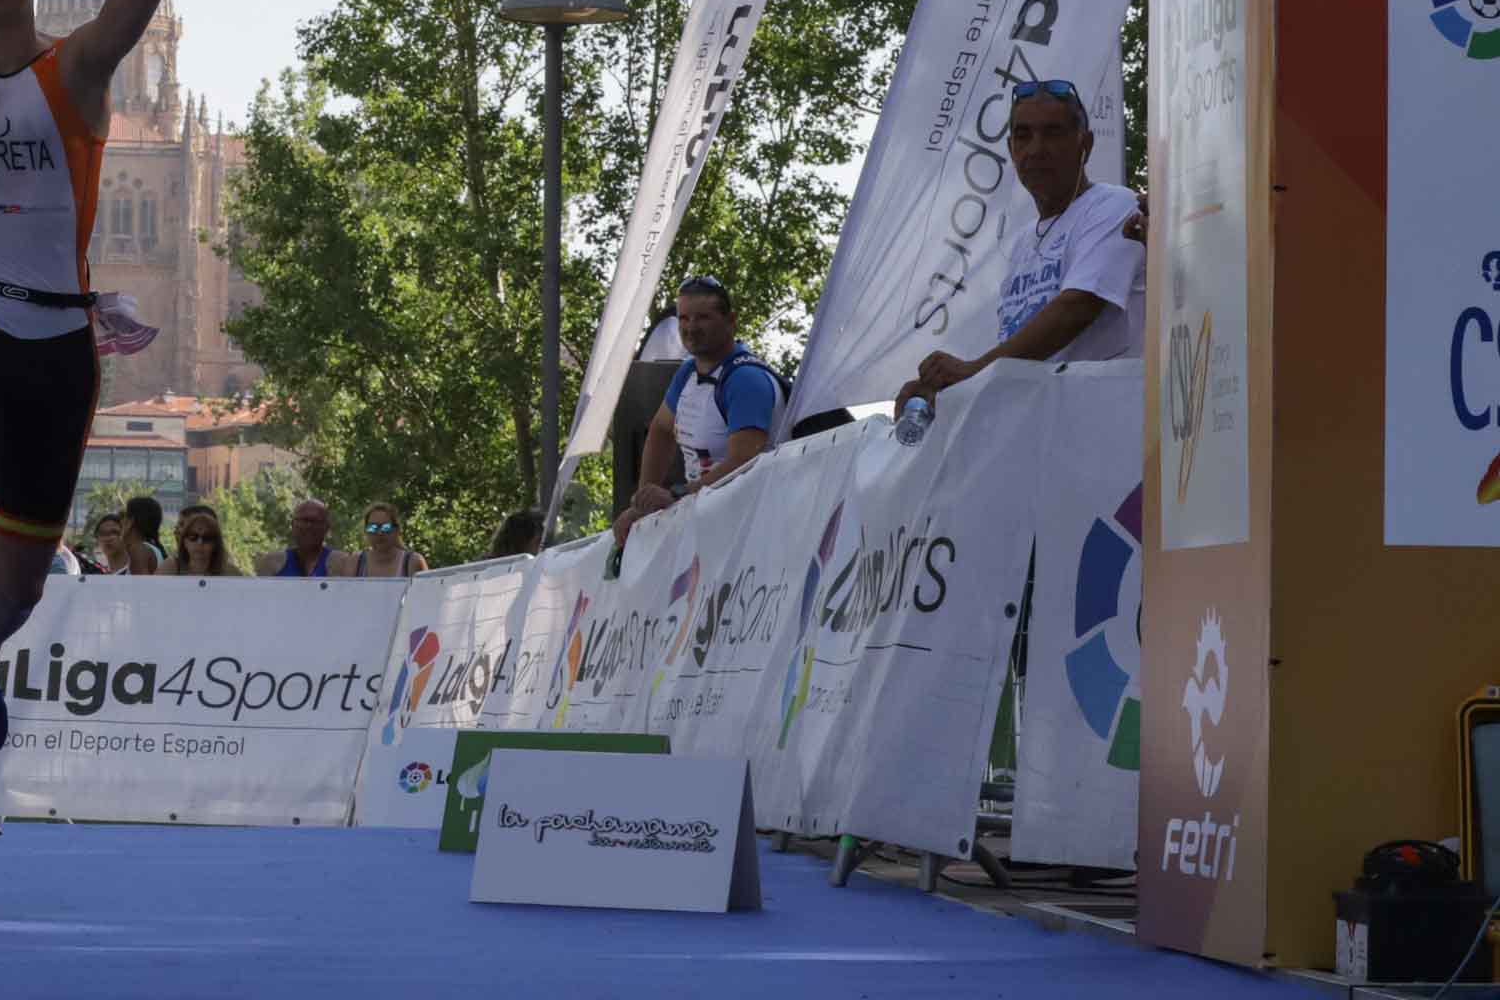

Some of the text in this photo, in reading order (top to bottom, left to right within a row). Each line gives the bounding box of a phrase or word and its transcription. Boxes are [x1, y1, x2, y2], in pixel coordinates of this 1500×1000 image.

[924, 50, 977, 152] Español
[44, 730, 62, 749] el
[70, 730, 155, 756] Deporte
[163, 733, 245, 757] Español
[499, 803, 530, 828] la
